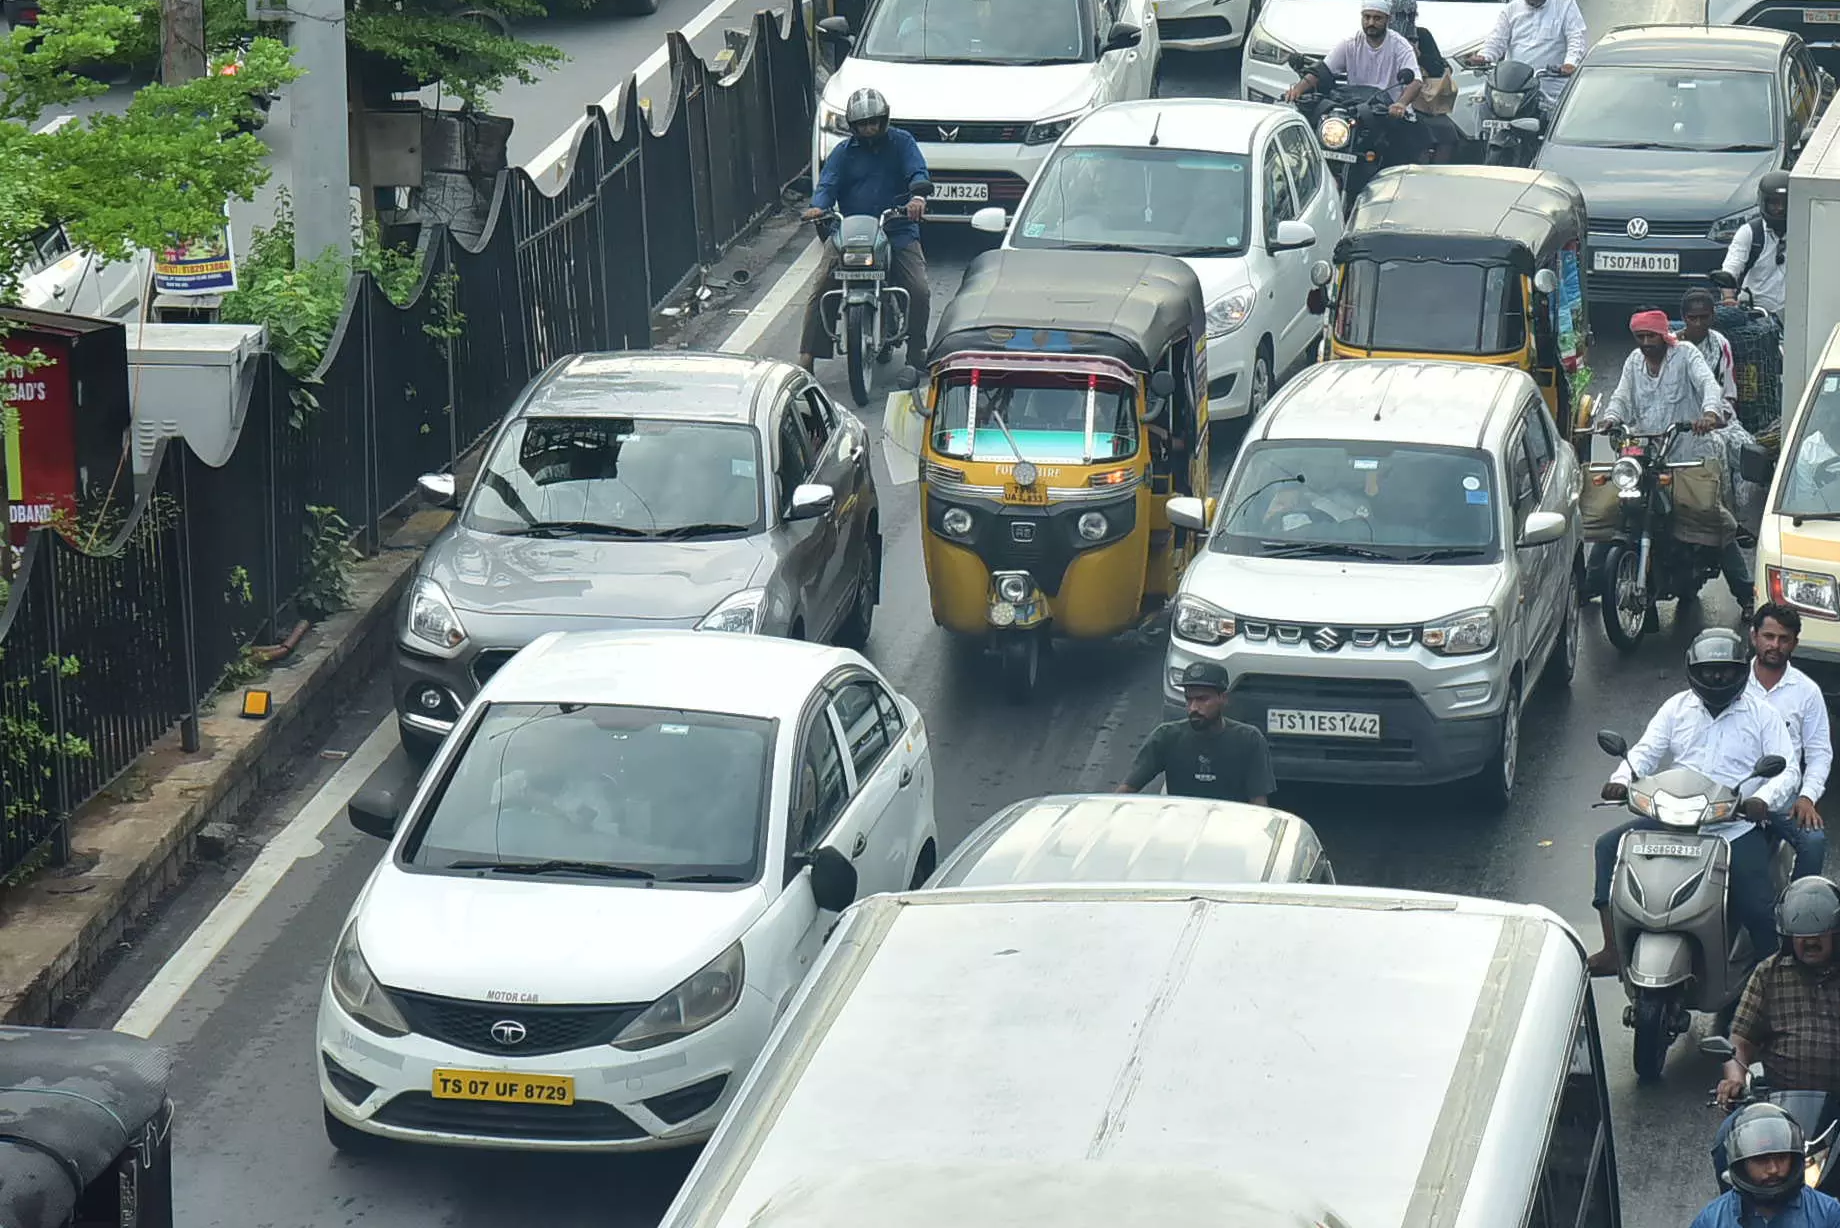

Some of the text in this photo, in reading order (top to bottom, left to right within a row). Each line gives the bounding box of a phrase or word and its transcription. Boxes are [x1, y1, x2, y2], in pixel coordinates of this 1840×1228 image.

[1602, 256, 1677, 270] TS07HA0101
[1278, 714, 1377, 734] TS11ES1442
[487, 990, 539, 1002] MOTOR CAB
[440, 1078, 566, 1100] TS 07 UF 8729
